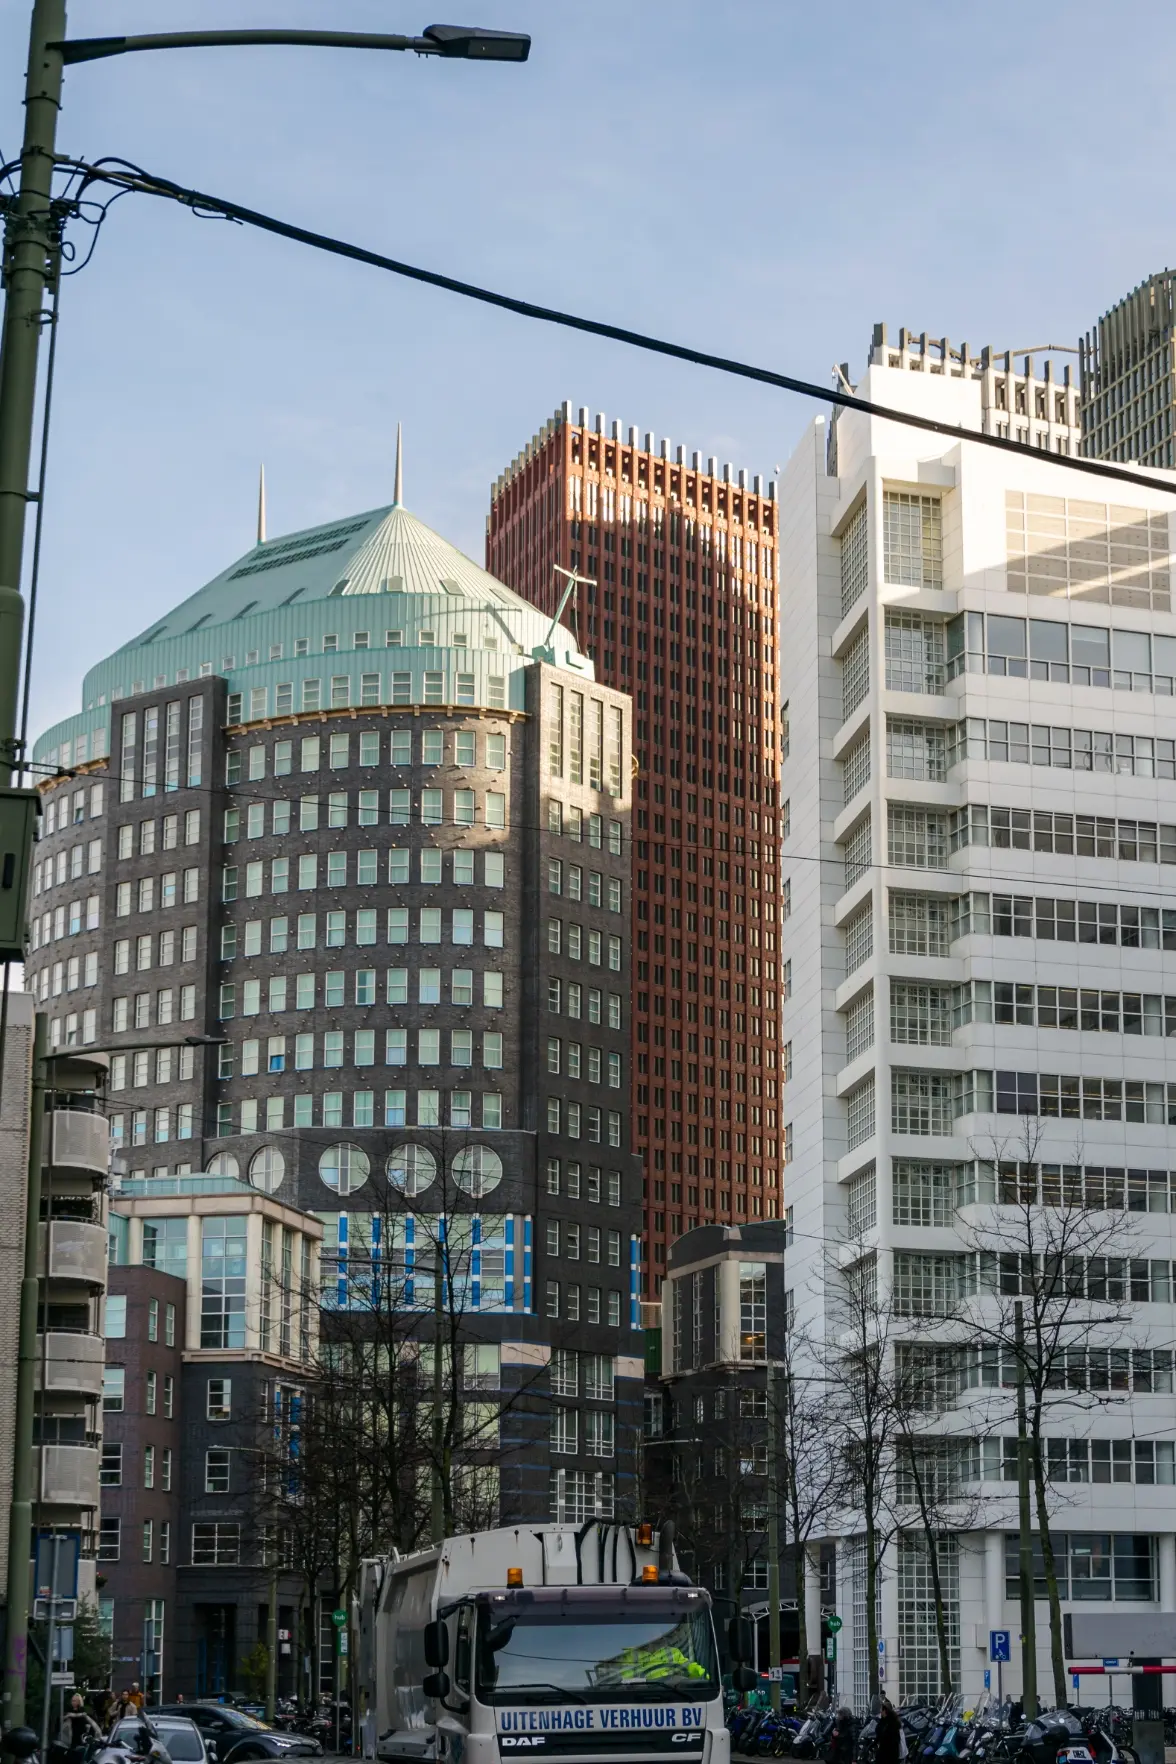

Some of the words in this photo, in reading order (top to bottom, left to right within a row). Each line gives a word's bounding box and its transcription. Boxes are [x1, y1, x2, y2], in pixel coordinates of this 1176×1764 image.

[995, 1633, 1006, 1649] P
[501, 1710, 594, 1730] UITENHAGE
[599, 1708, 676, 1728] VERHUUR
[681, 1707, 702, 1727] BV
[502, 1737, 546, 1747] DAF
[671, 1733, 702, 1743] CF
